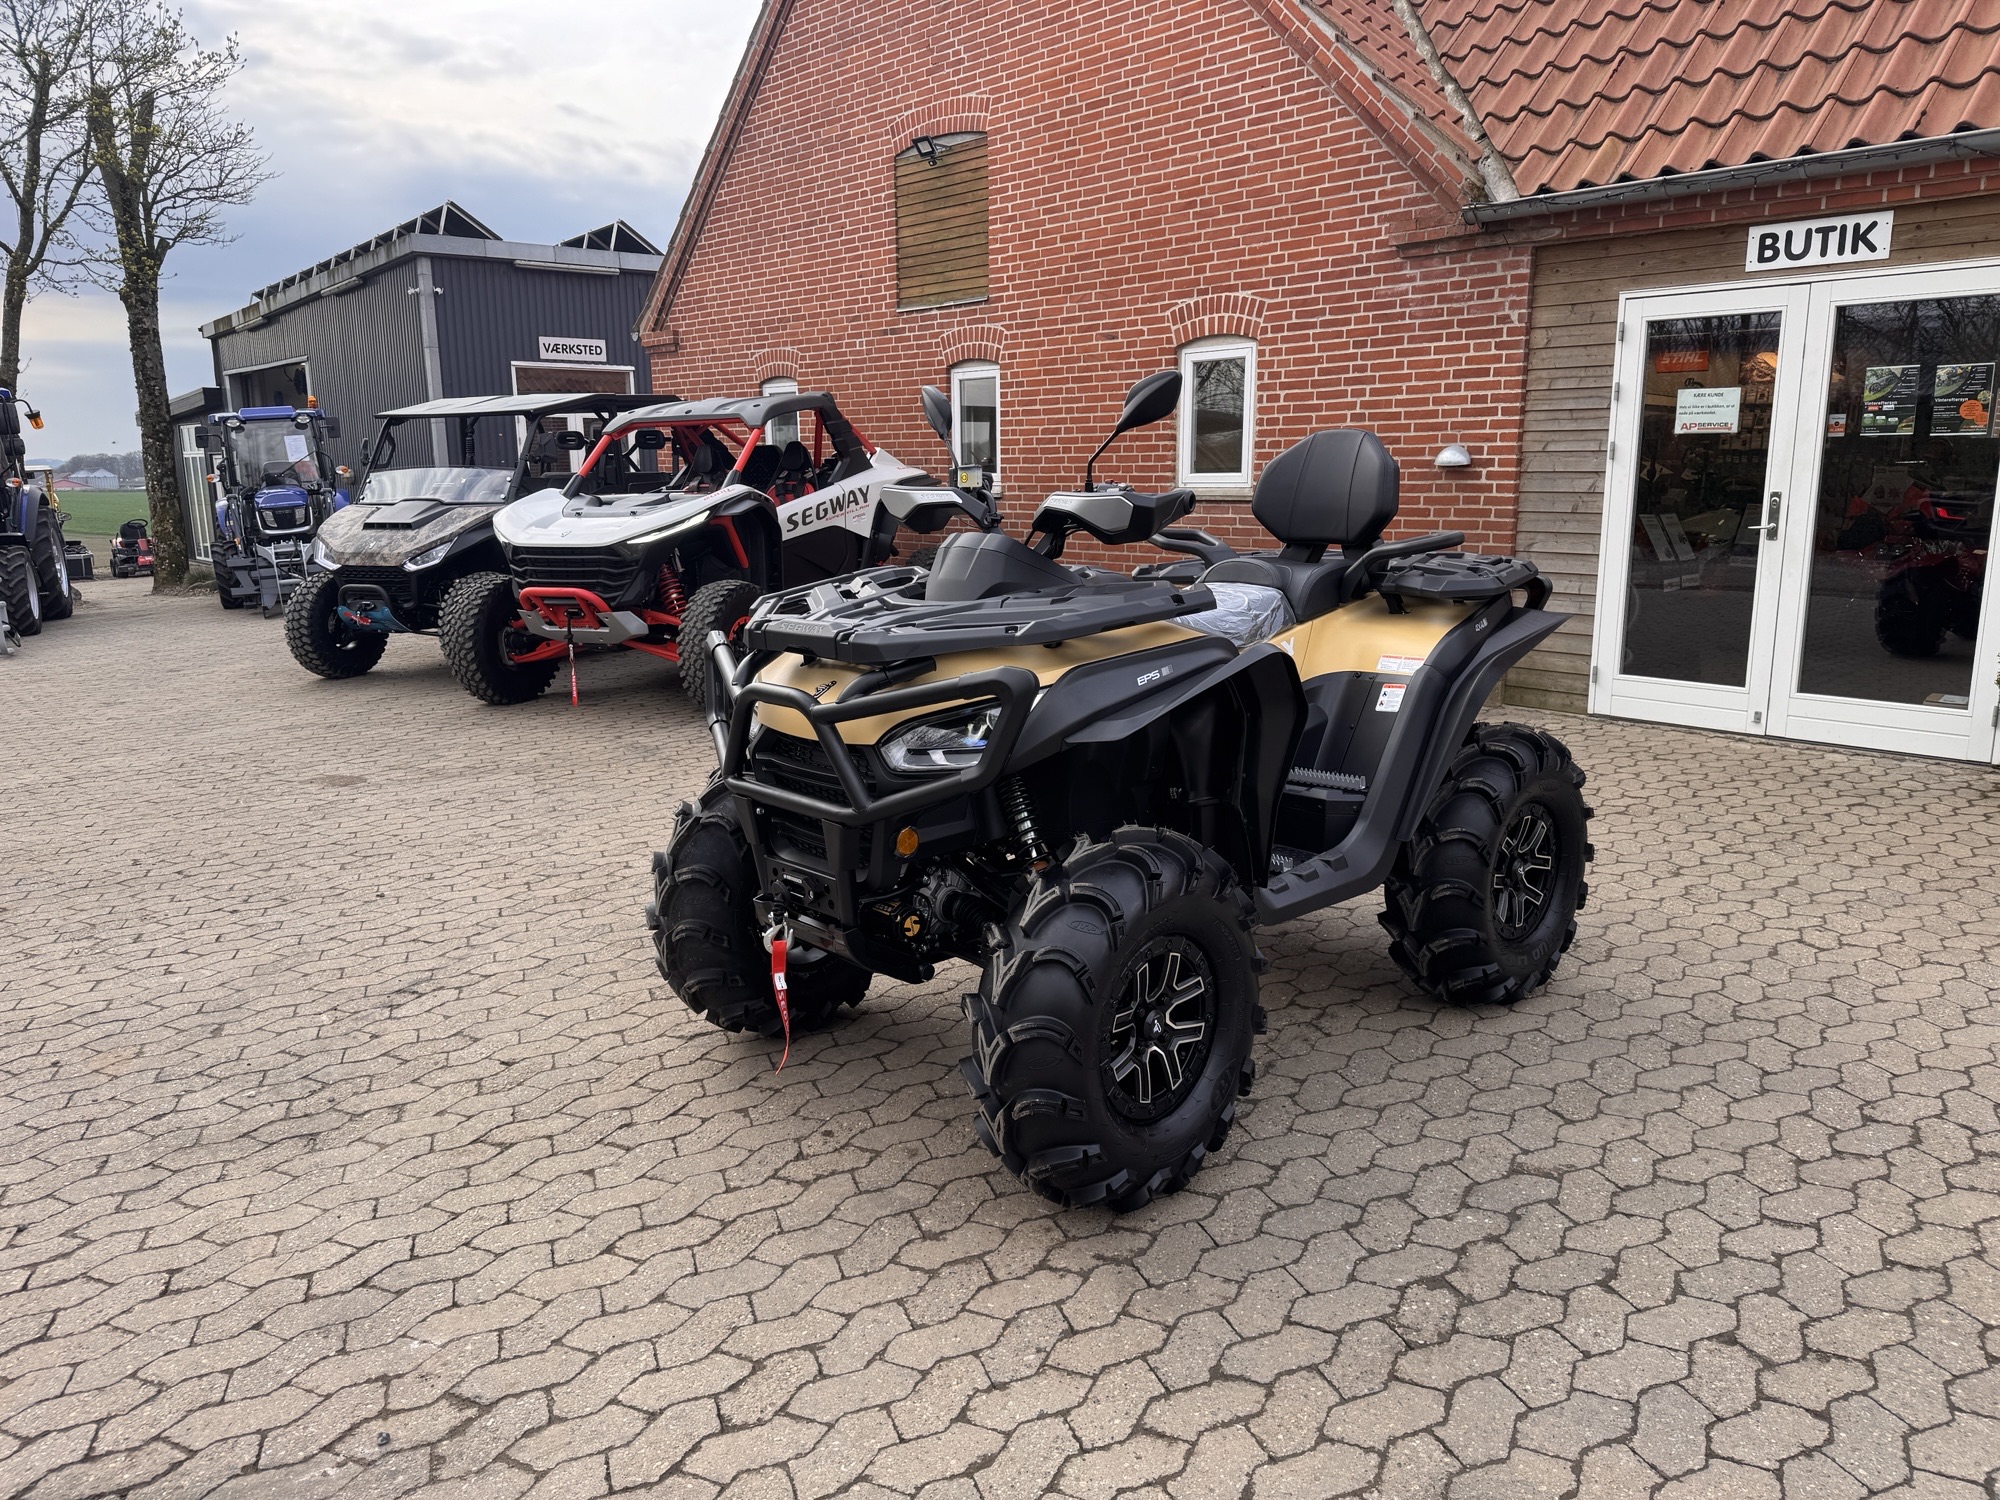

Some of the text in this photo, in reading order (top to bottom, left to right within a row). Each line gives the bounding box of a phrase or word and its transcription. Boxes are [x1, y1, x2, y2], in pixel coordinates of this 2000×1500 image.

[1757, 220, 1878, 263] BUTIK
[543, 343, 602, 355] VÆRKSTED
[1661, 352, 1703, 364] STIHL
[1680, 422, 1698, 431] AP
[786, 485, 870, 532] SEGWAY
[780, 622, 826, 634] SEGWAY
[1137, 669, 1160, 686] EPS
